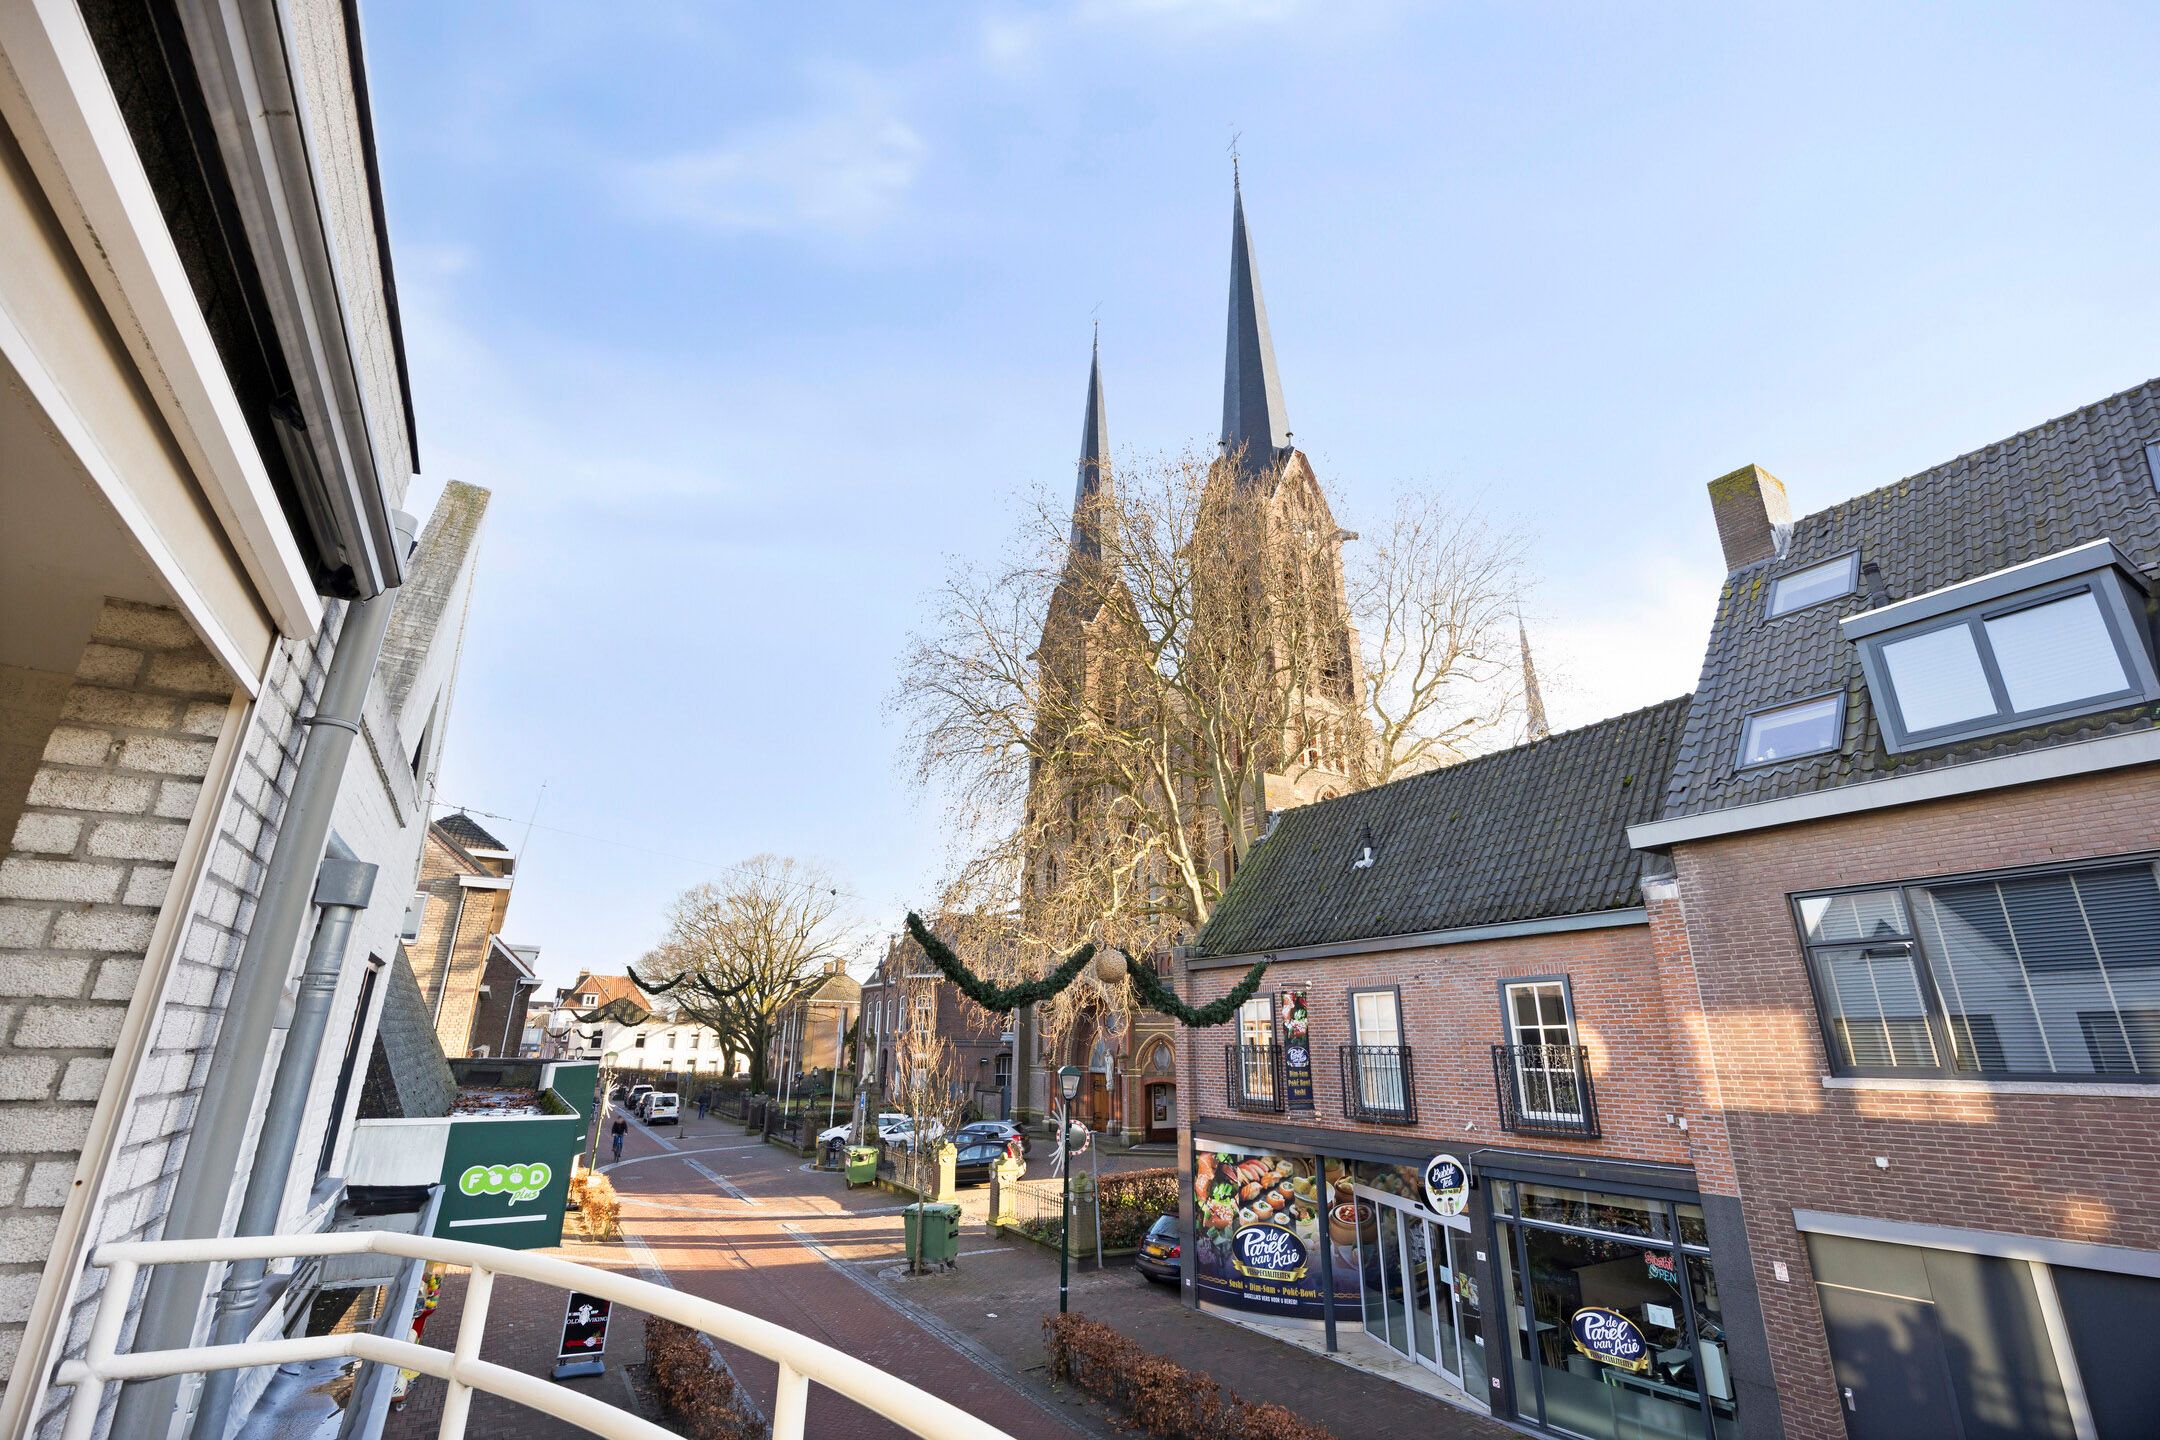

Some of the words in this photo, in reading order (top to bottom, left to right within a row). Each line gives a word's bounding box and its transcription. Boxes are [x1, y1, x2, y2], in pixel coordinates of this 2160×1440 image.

[468, 1168, 544, 1188] FOOD
[1432, 1163, 1455, 1182] Bubble
[1440, 1176, 1453, 1188] Tea
[510, 1188, 538, 1205] plus
[1236, 1228, 1289, 1256] Parel
[1266, 1229, 1279, 1241] de
[1251, 1255, 1271, 1265] van
[1268, 1249, 1300, 1269] Azië
[1649, 1264, 1677, 1283] OPEN
[1229, 1280, 1243, 1289] Sushi
[1576, 1312, 1628, 1340] Parel
[1606, 1316, 1618, 1327] de
[1594, 1340, 1612, 1348] van
[1611, 1339, 1640, 1355] Azië
